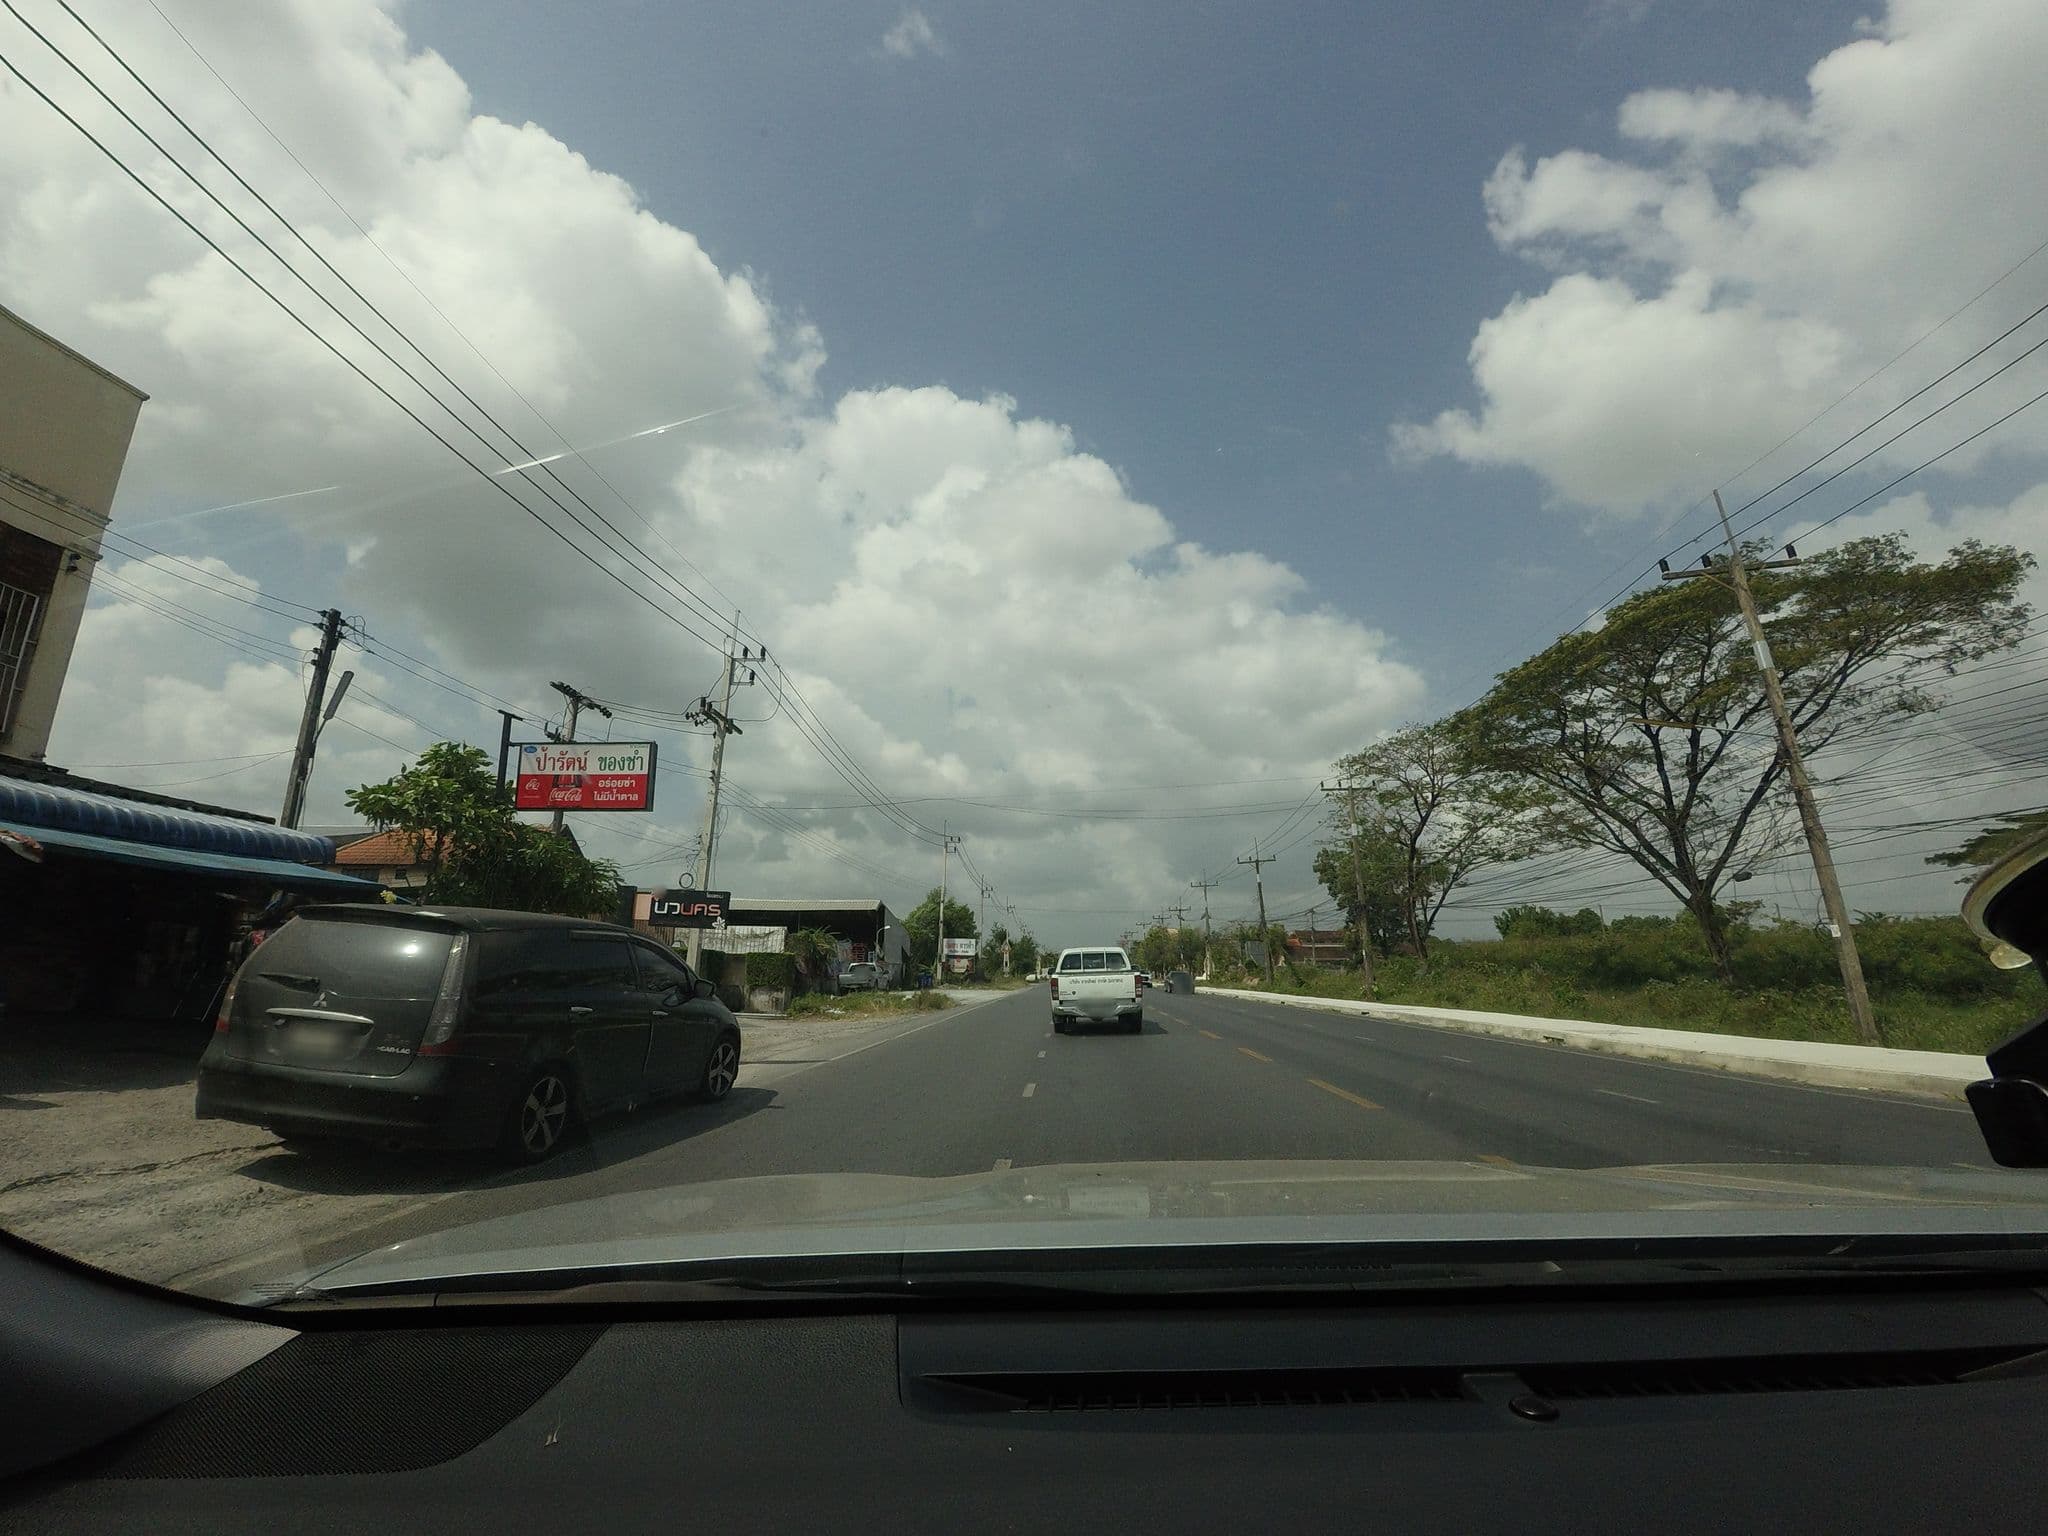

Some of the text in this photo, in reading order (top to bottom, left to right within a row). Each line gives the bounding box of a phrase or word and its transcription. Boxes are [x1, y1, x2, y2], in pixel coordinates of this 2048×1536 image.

[535, 746, 644, 772] ป้ารัตน์ ของชำ
